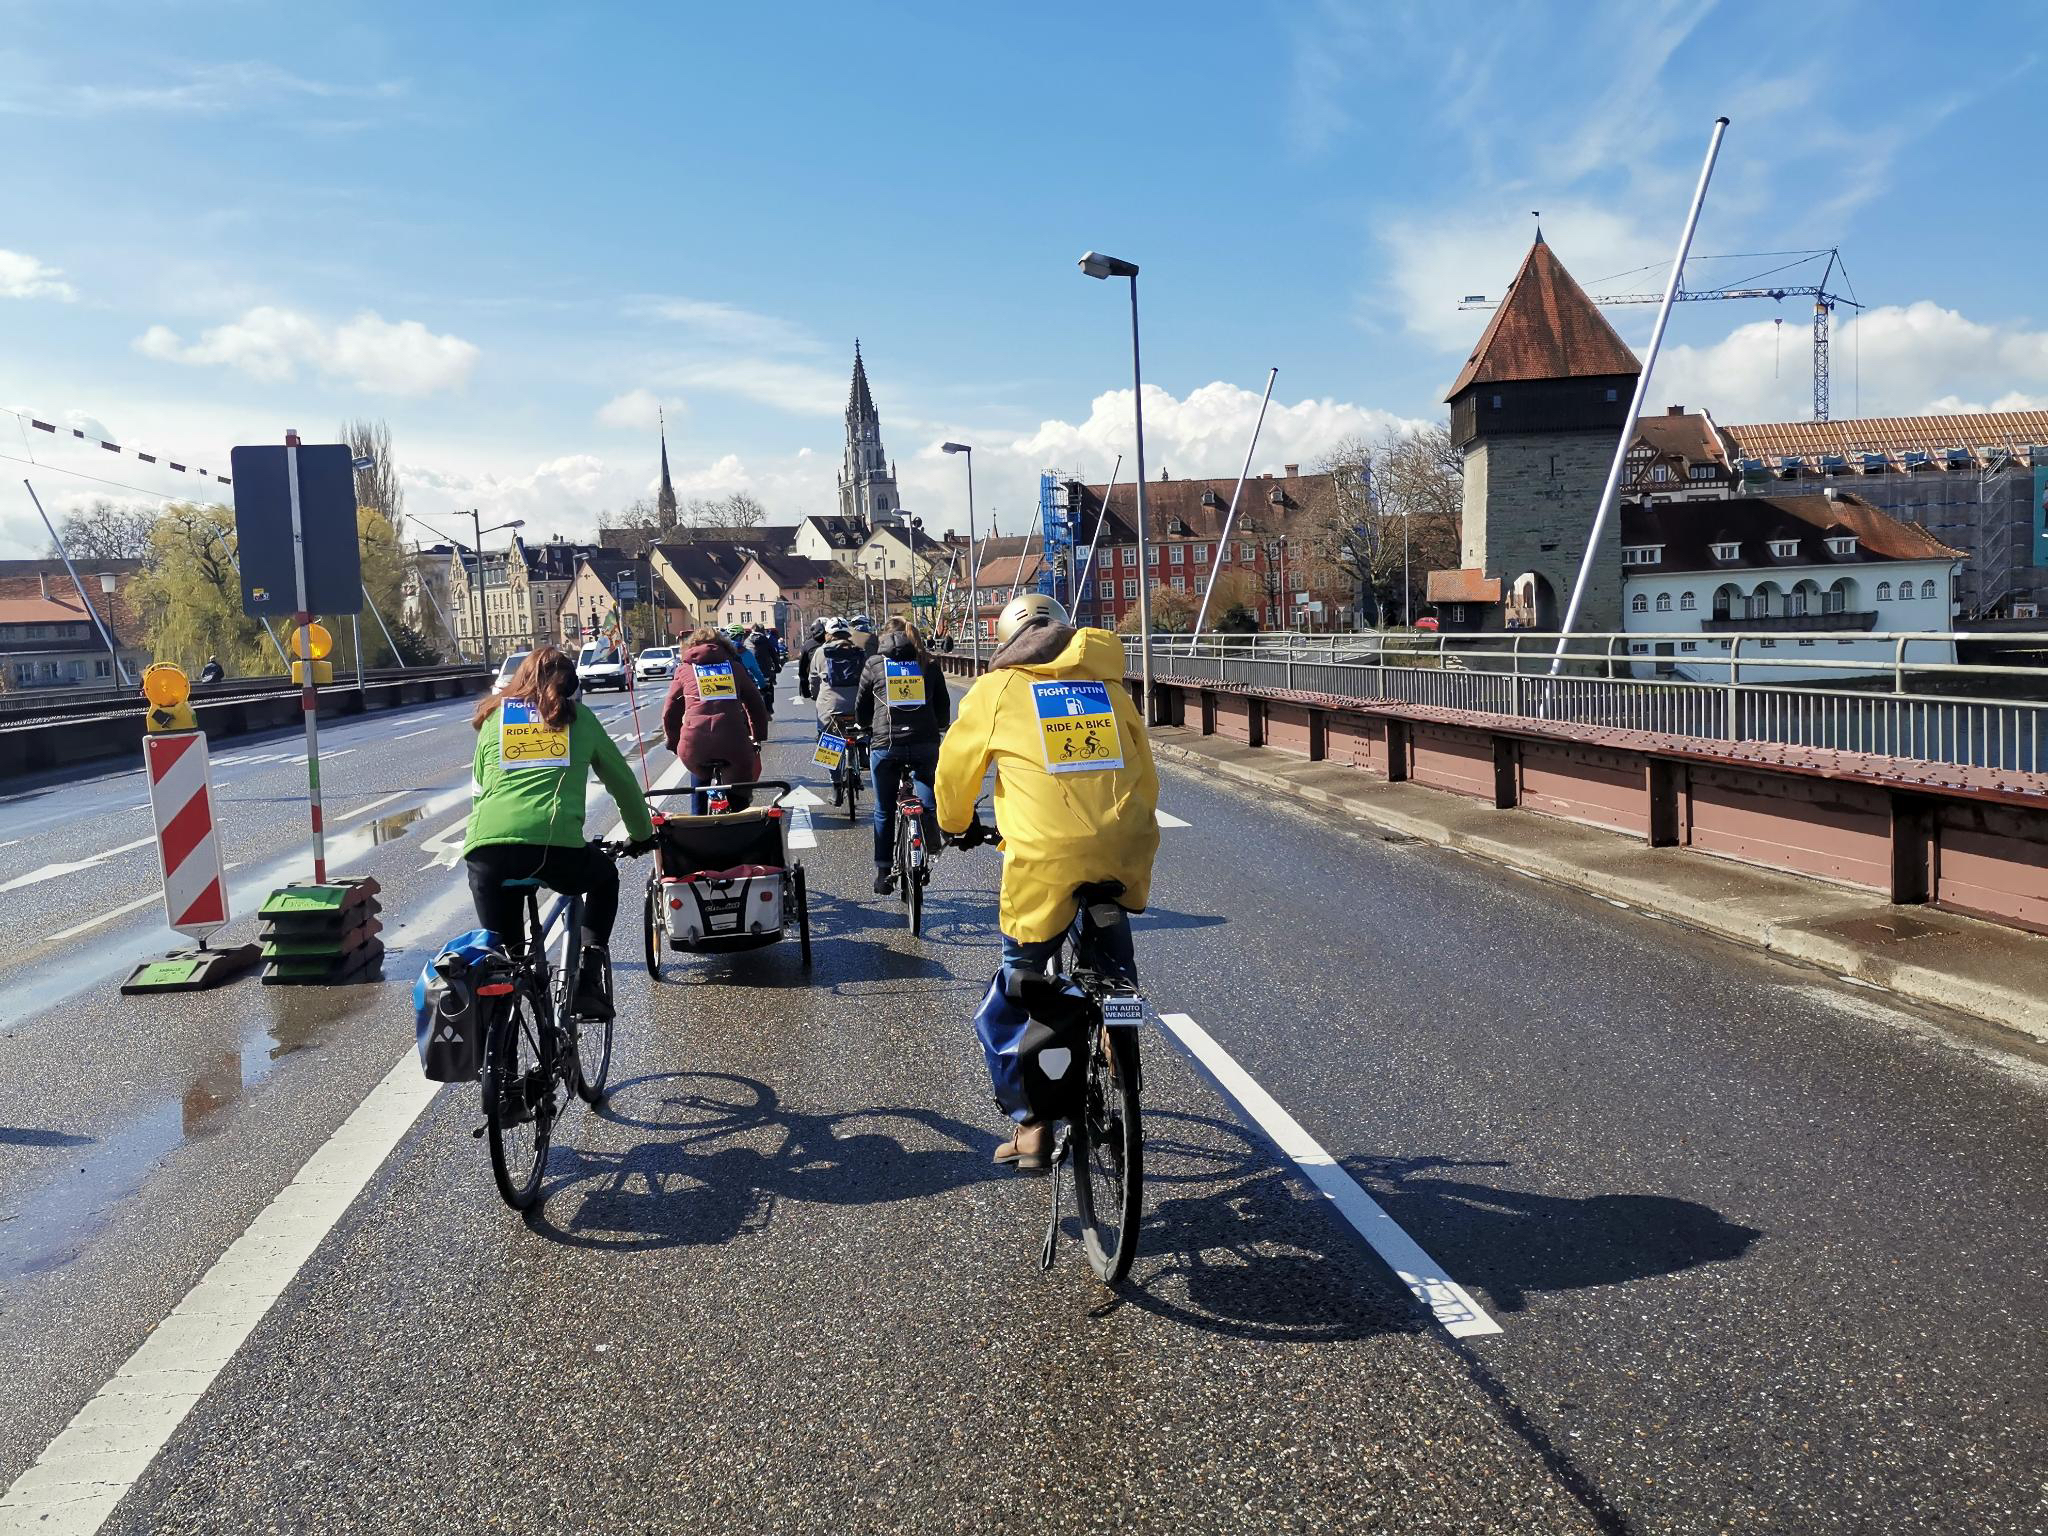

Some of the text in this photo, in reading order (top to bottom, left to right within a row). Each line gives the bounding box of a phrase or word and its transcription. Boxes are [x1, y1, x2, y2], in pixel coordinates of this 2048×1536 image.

[1037, 686, 1104, 696] FIGHT PUTIN
[1046, 719, 1111, 732] RIDE A BIKE
